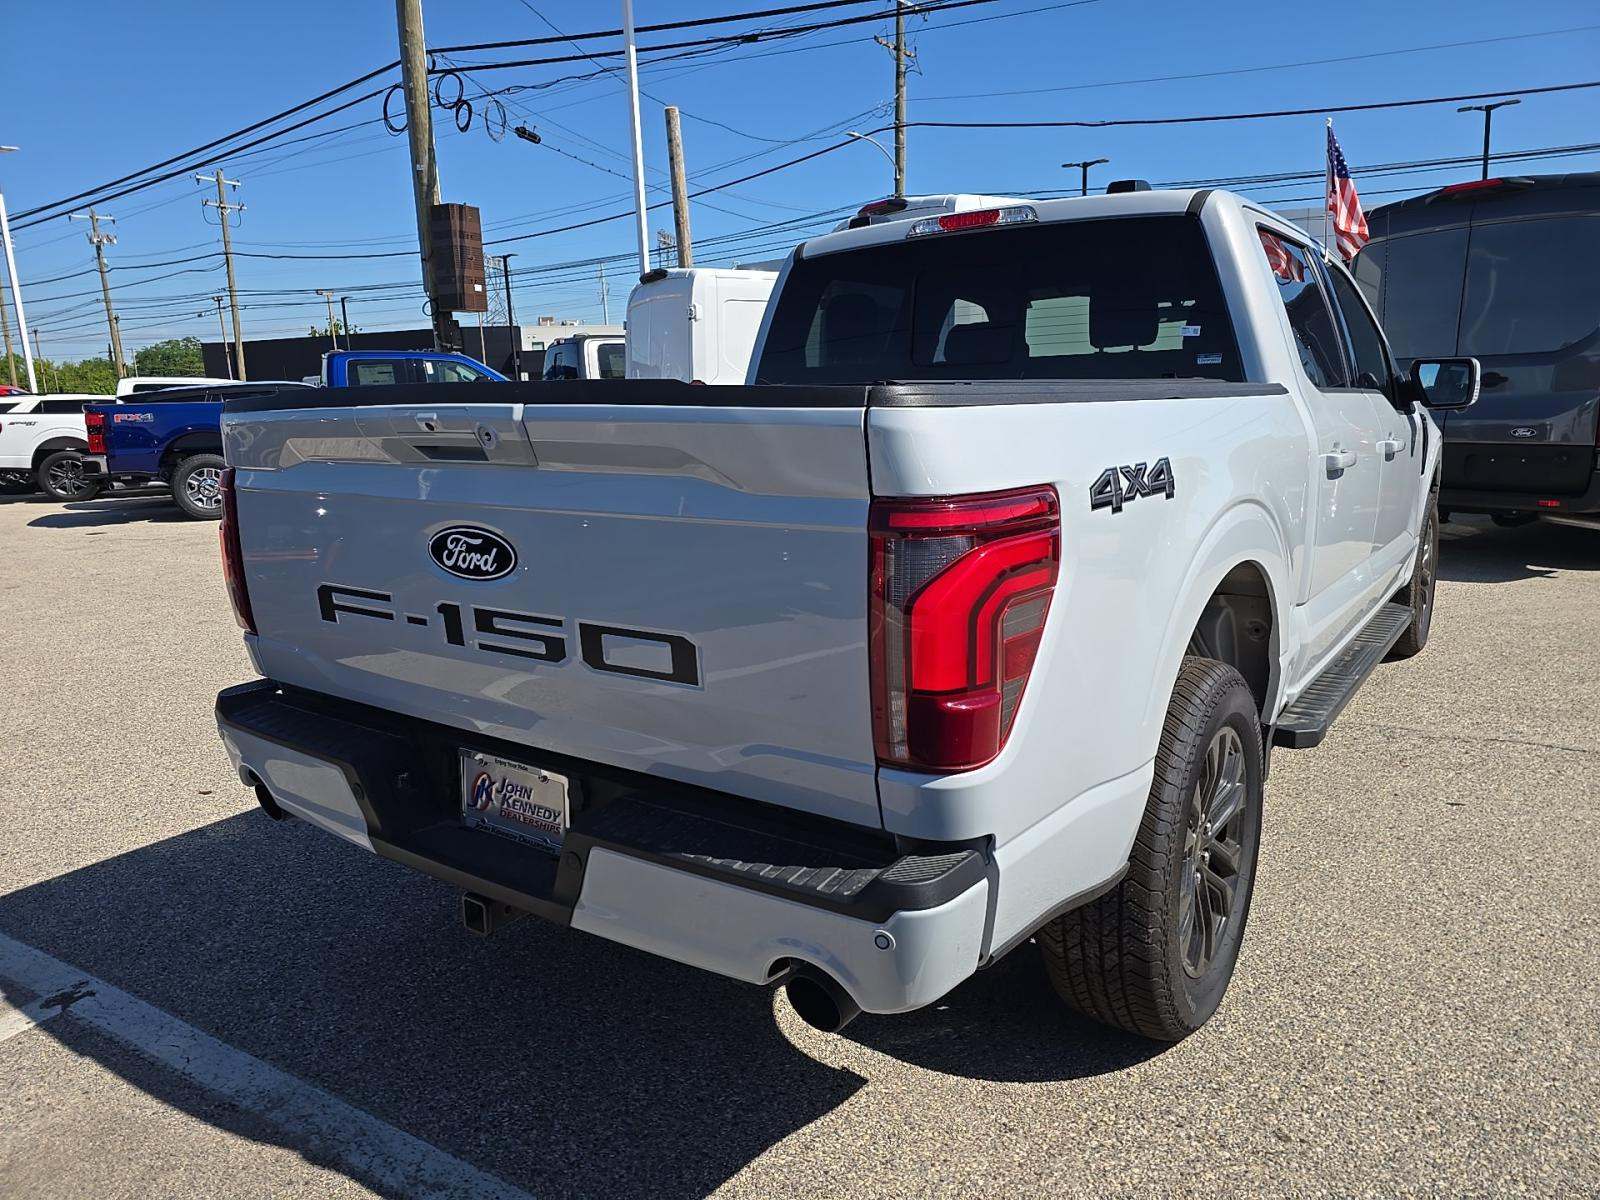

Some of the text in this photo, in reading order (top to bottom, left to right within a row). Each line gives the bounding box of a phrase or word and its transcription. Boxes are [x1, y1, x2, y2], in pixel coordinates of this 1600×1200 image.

[443, 534, 498, 573] Ford
[316, 582, 704, 690] F-150
[500, 809, 562, 835] DEALERSHIPS
[501, 792, 561, 822] KENNEDY
